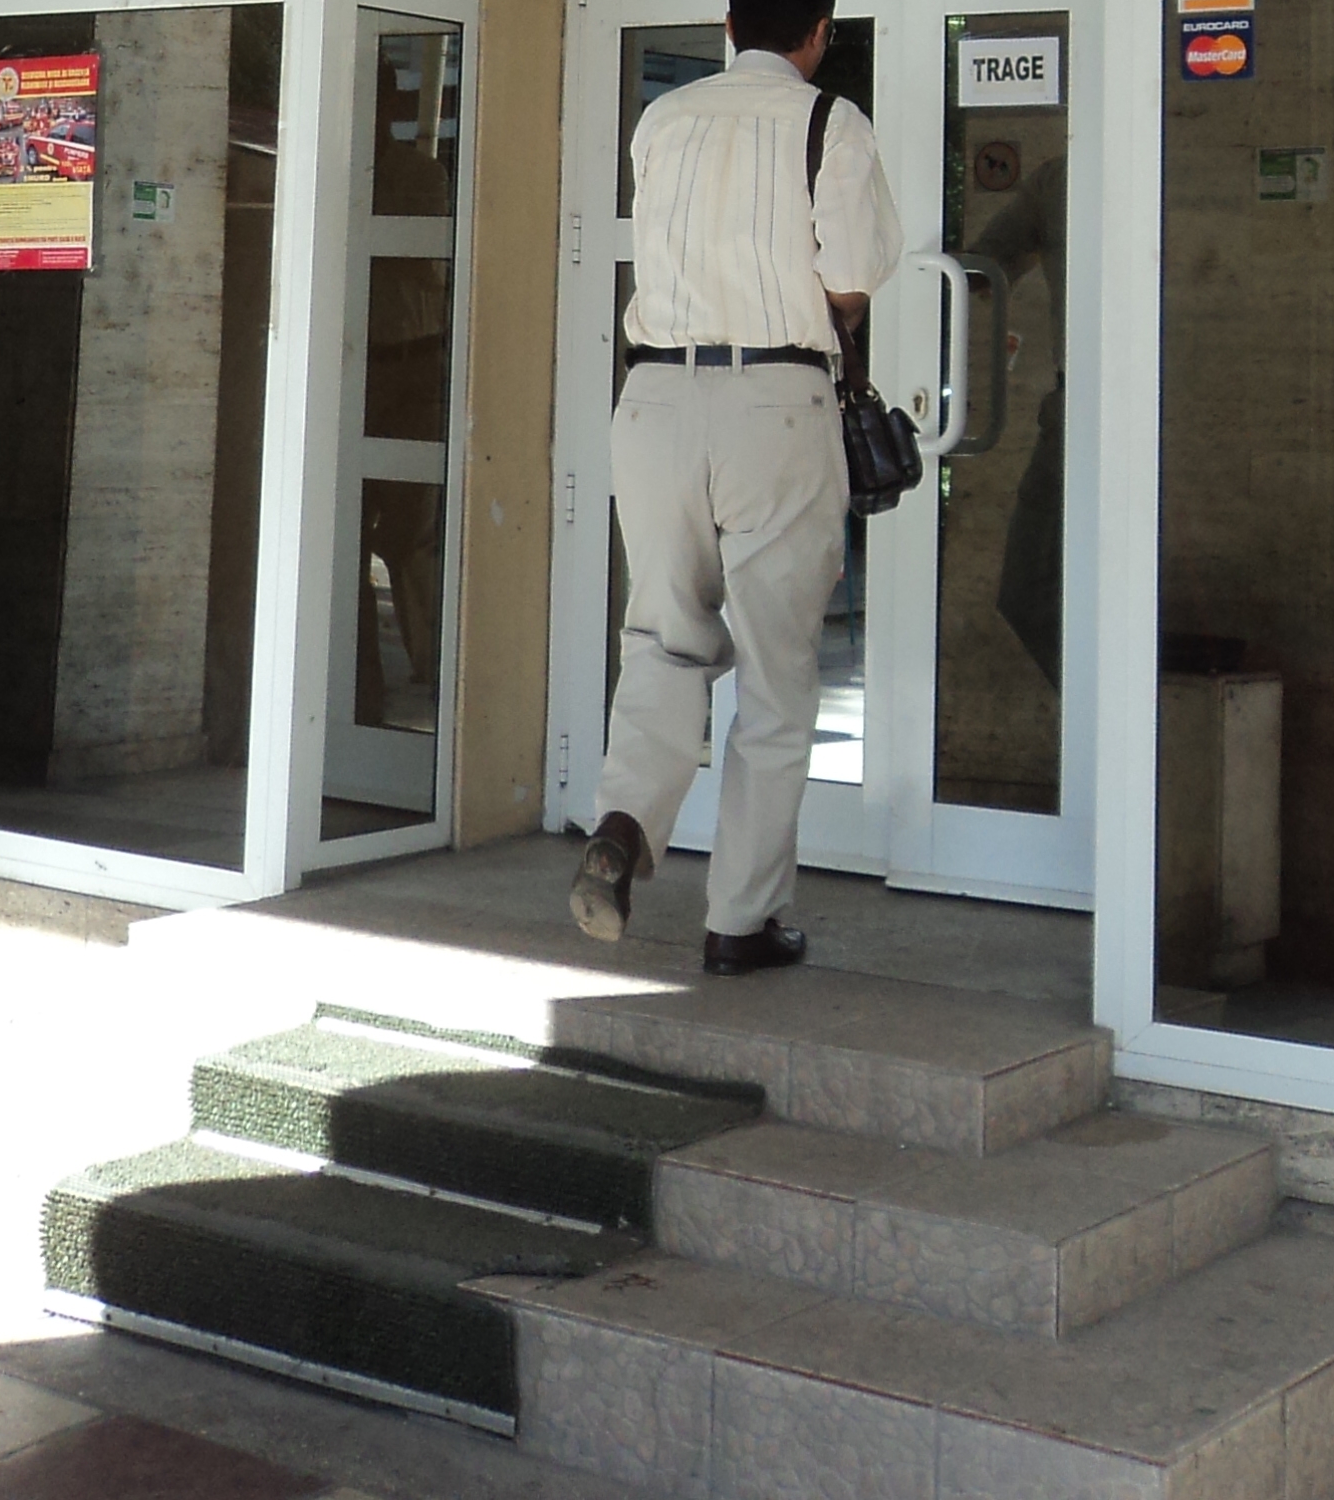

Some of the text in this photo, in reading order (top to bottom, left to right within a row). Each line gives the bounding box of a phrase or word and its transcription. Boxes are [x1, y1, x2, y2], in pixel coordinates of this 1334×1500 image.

[1182, 19, 1250, 32] EUROCARD
[1187, 48, 1247, 64] MasterCard
[973, 55, 1045, 83] TRAGE
